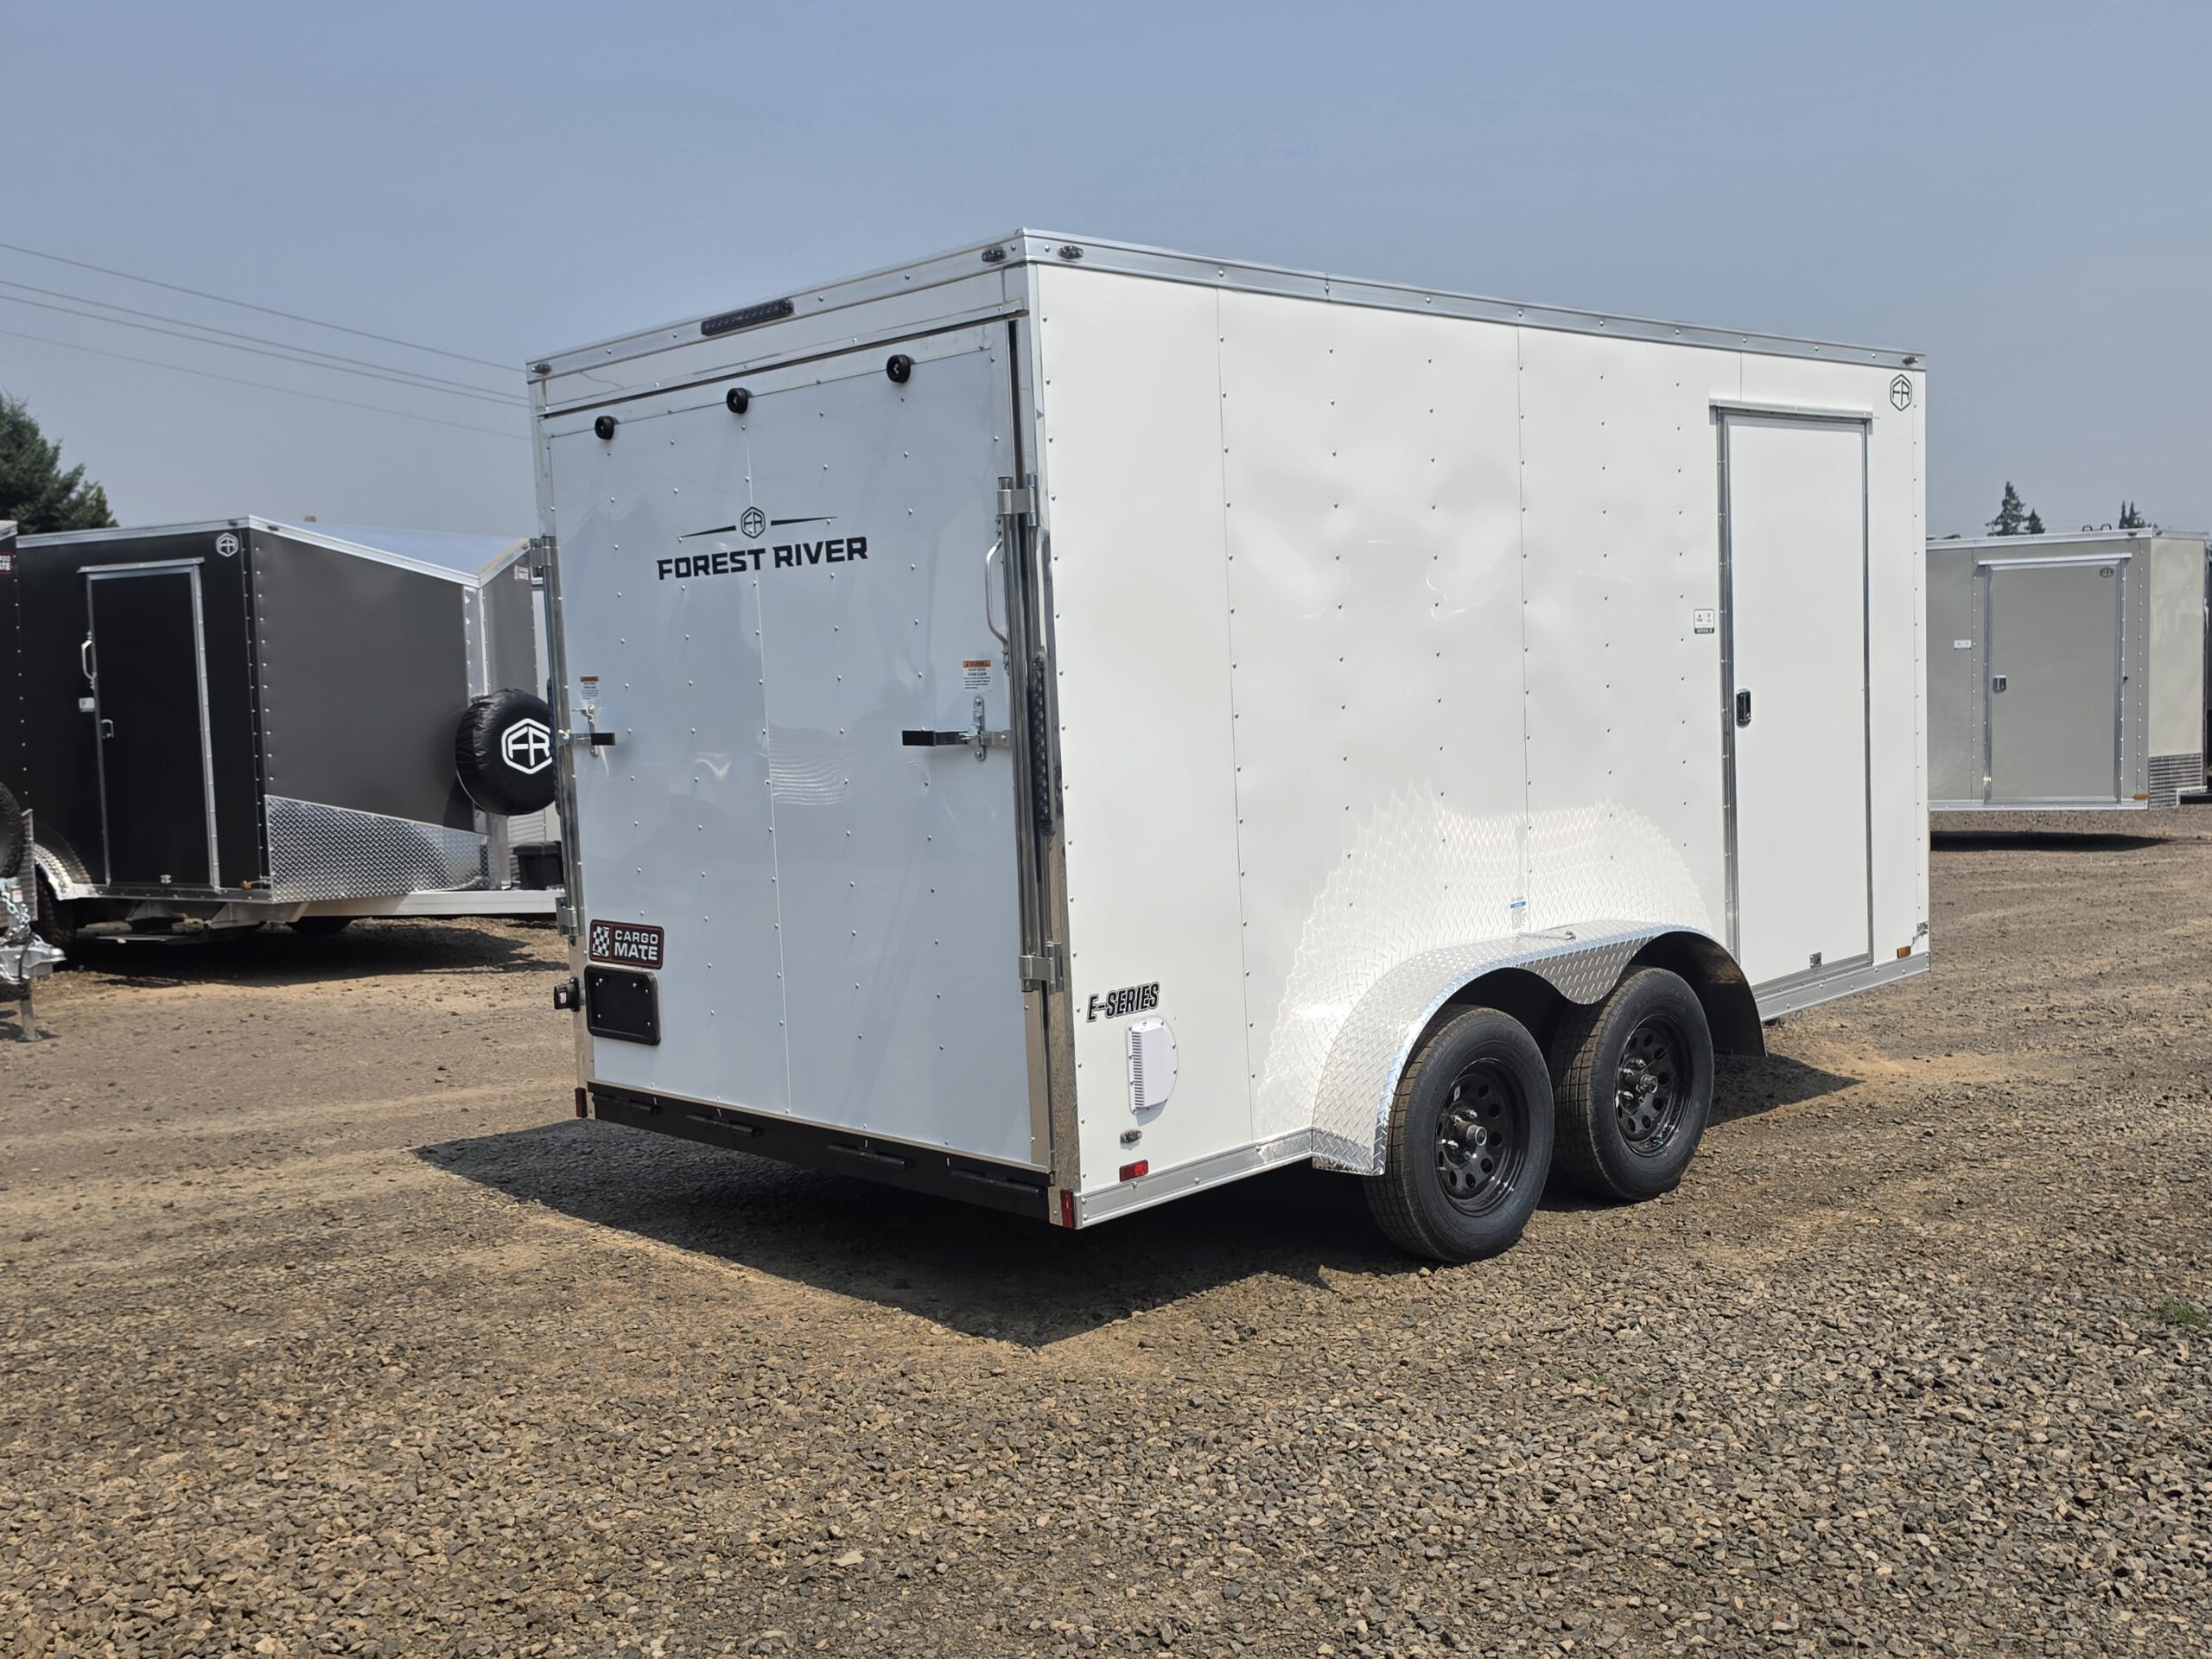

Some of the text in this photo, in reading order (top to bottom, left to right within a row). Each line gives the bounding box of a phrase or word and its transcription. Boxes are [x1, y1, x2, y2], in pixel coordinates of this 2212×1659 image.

[657, 536, 868, 580] FOREST RIVER
[614, 930, 658, 944] CARGO
[614, 942, 658, 961] MATE
[1087, 982, 1160, 1022] E-SERIES
